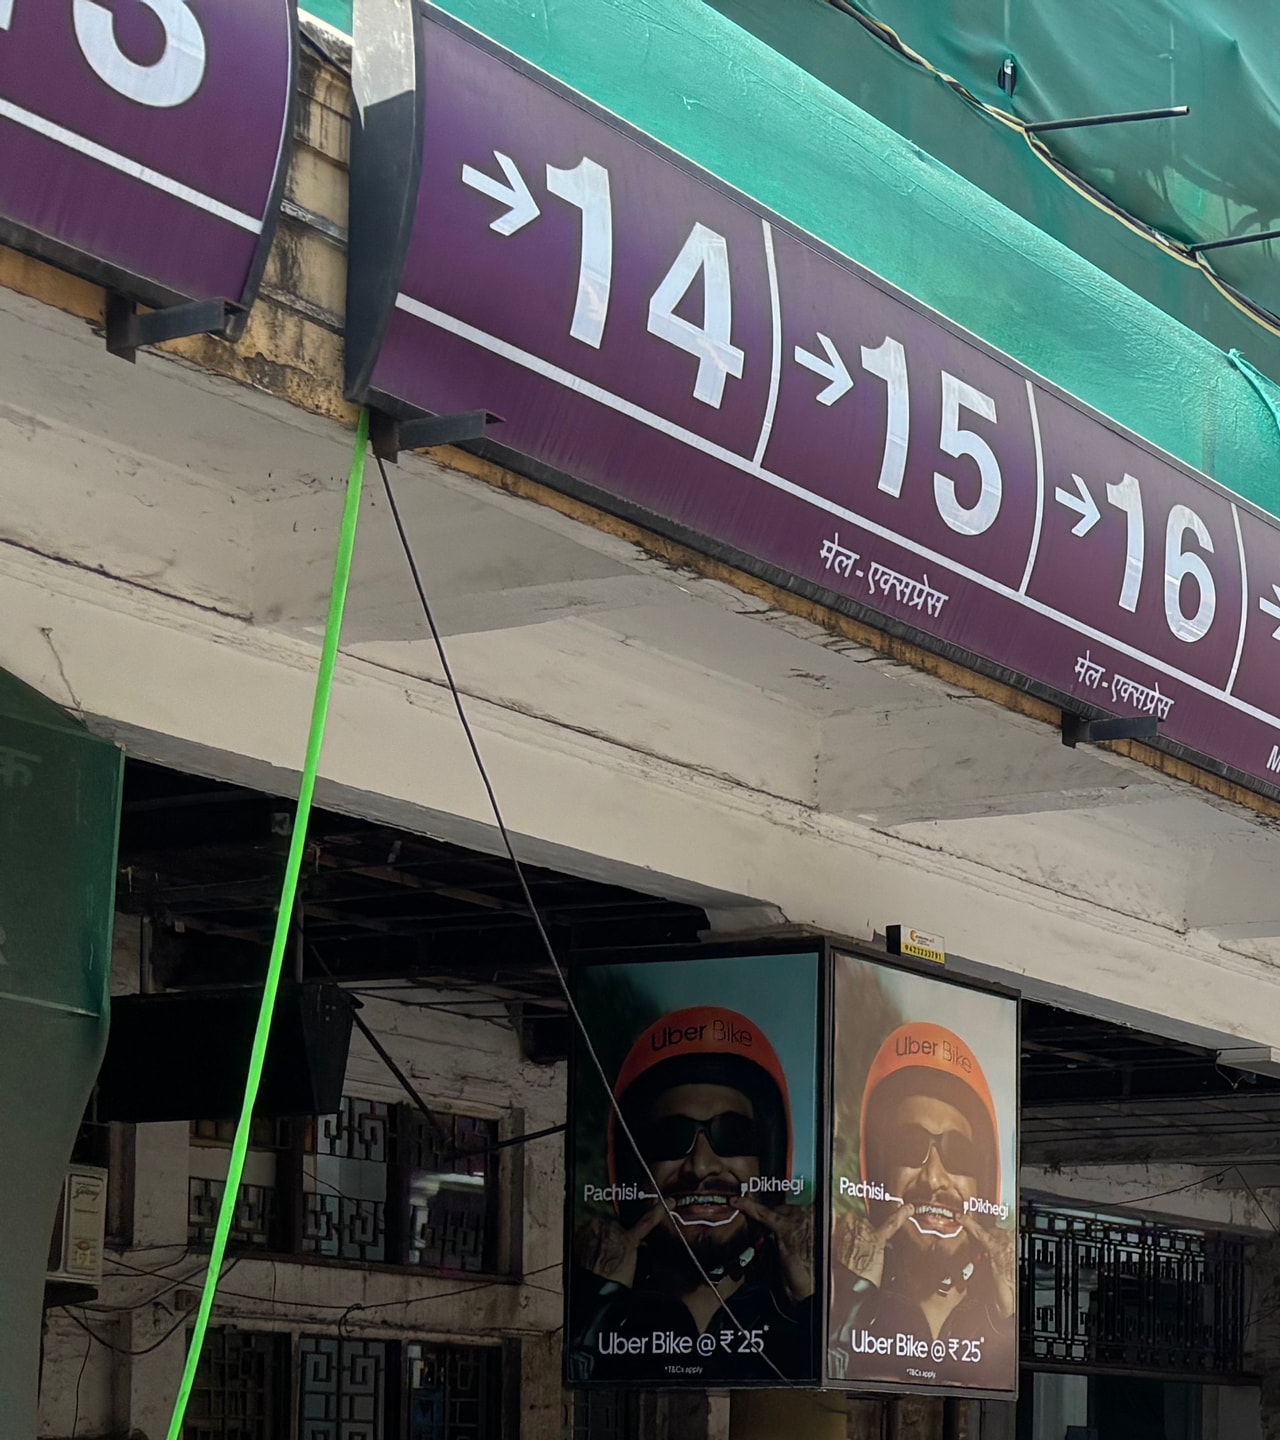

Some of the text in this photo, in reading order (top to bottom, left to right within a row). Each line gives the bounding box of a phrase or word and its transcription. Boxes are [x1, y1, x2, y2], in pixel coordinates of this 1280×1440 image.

[546, 156, 743, 409] 14
[861, 336, 1002, 536] 15
[1106, 472, 1216, 644] 16
[651, 1019, 753, 1051] Uber Bike
[895, 1035, 972, 1073] Uber Bike
[584, 1175, 804, 1202] Pachisi Dikhegi
[839, 1177, 1009, 1220] Pachisi Dikhegi
[598, 1331, 649, 1355] Uber
[652, 1331, 693, 1354] Bike
[851, 1329, 894, 1355] Uber
[896, 1333, 928, 1358] Bike
